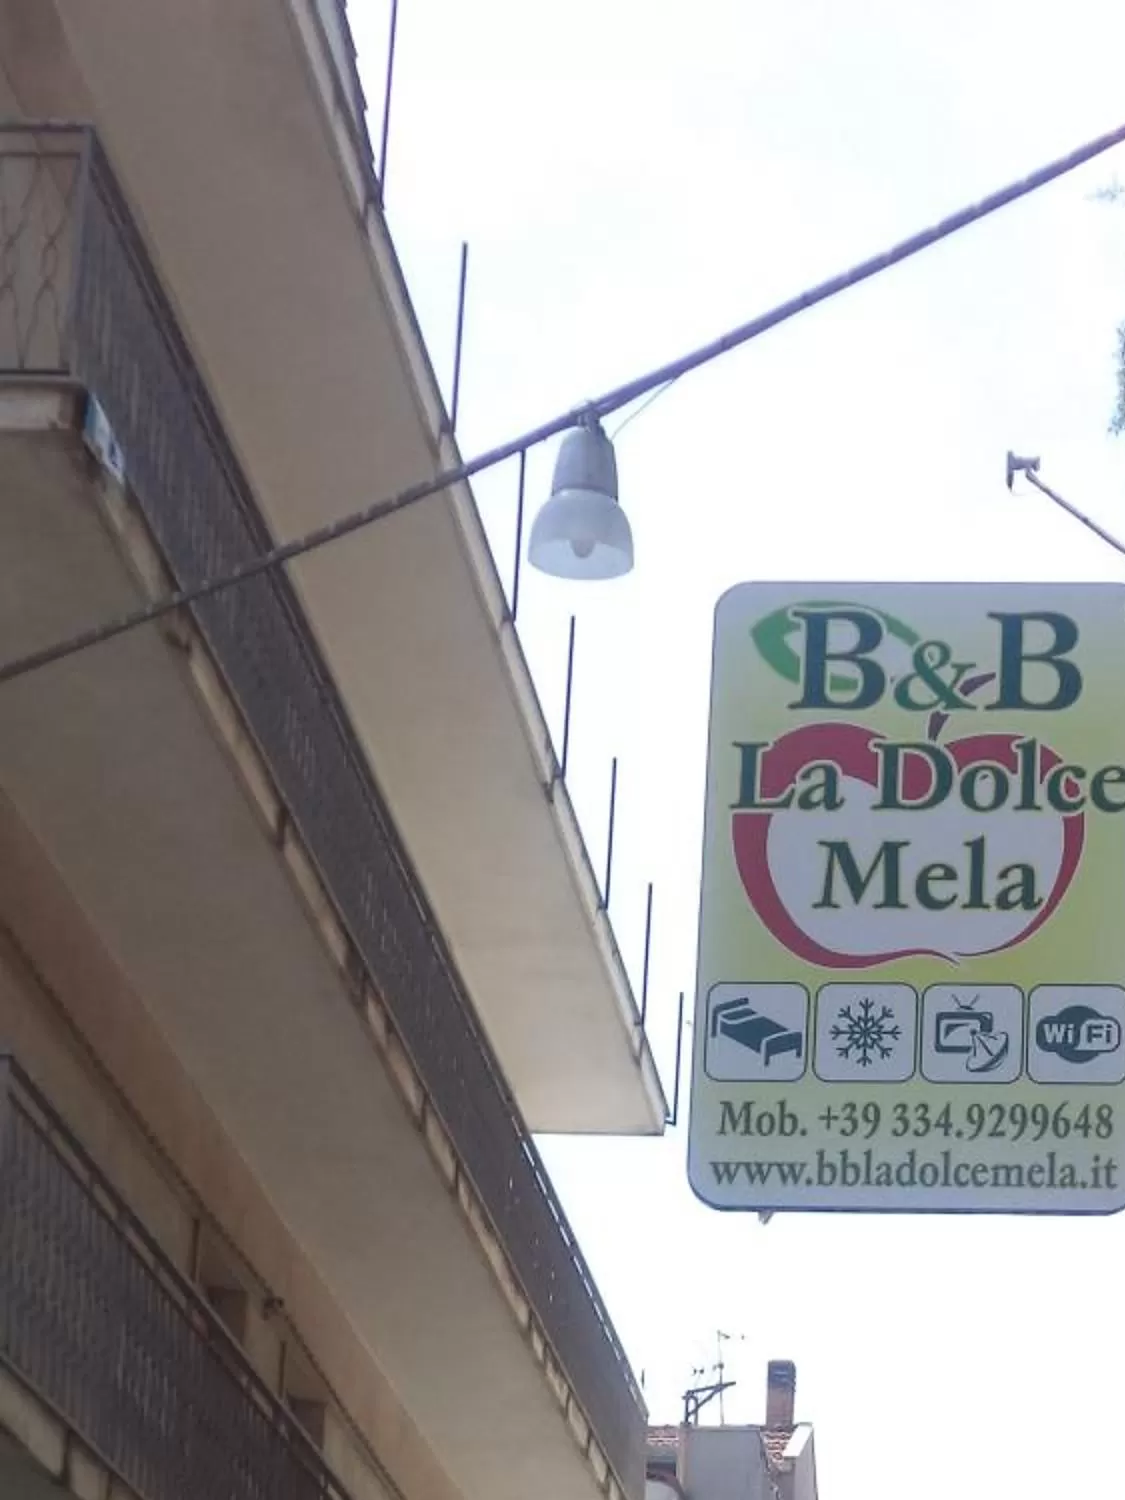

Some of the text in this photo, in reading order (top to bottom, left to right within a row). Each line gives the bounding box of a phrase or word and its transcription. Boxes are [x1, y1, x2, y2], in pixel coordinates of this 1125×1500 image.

[788, 610, 1084, 711] B&B
[729, 741, 845, 812] La
[812, 836, 1044, 911] Mela
[716, 1100, 1114, 1140] Mob. +39 334.9299648
[710, 1149, 1119, 1190] www.bbladolcemela.it
